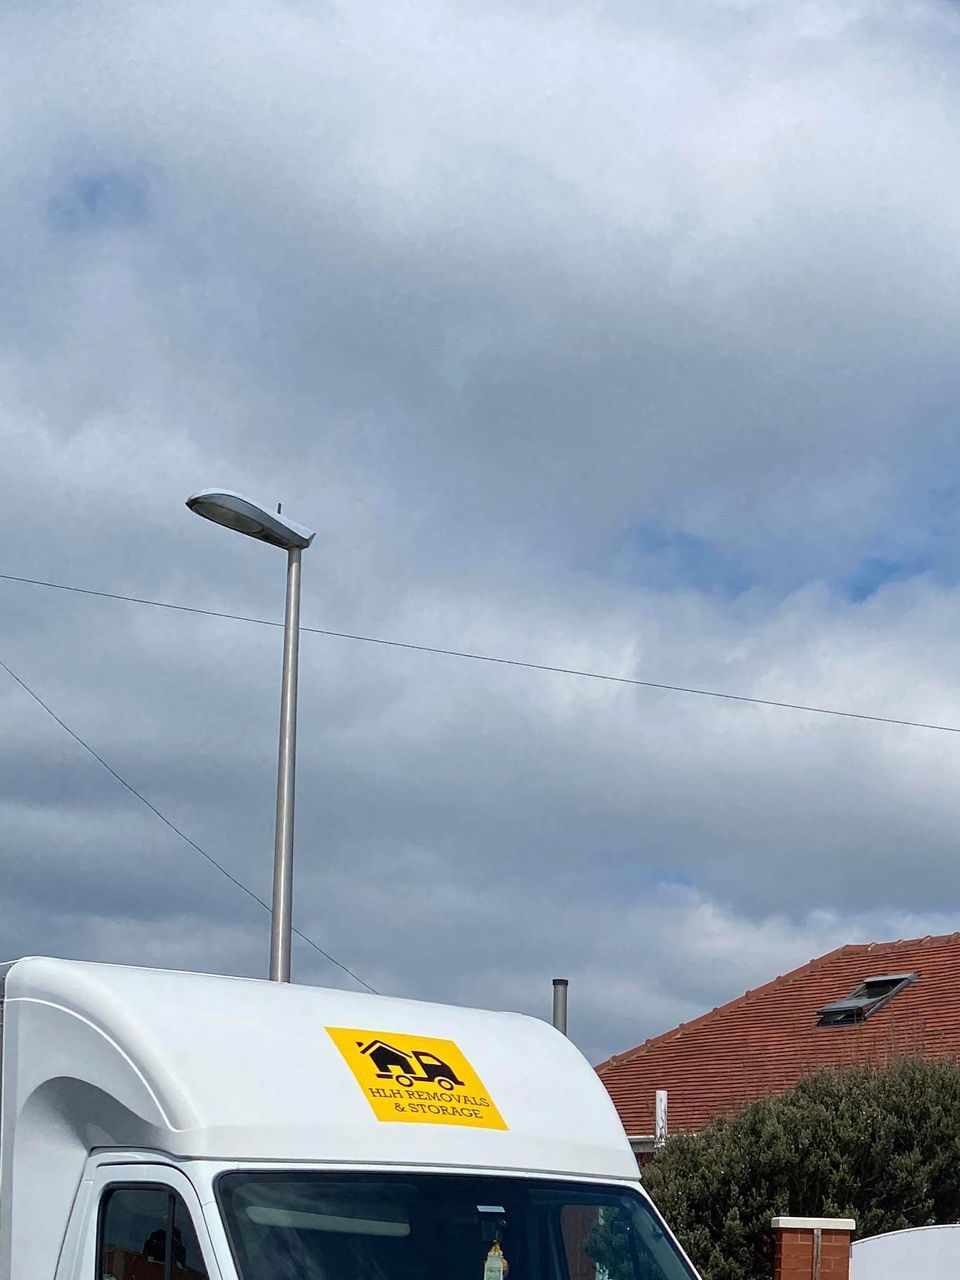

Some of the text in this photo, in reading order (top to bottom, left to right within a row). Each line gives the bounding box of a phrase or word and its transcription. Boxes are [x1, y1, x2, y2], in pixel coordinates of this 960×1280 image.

[369, 1087, 490, 1107] HLH REMOVALS
[394, 1102, 483, 1118] & STORAGE
